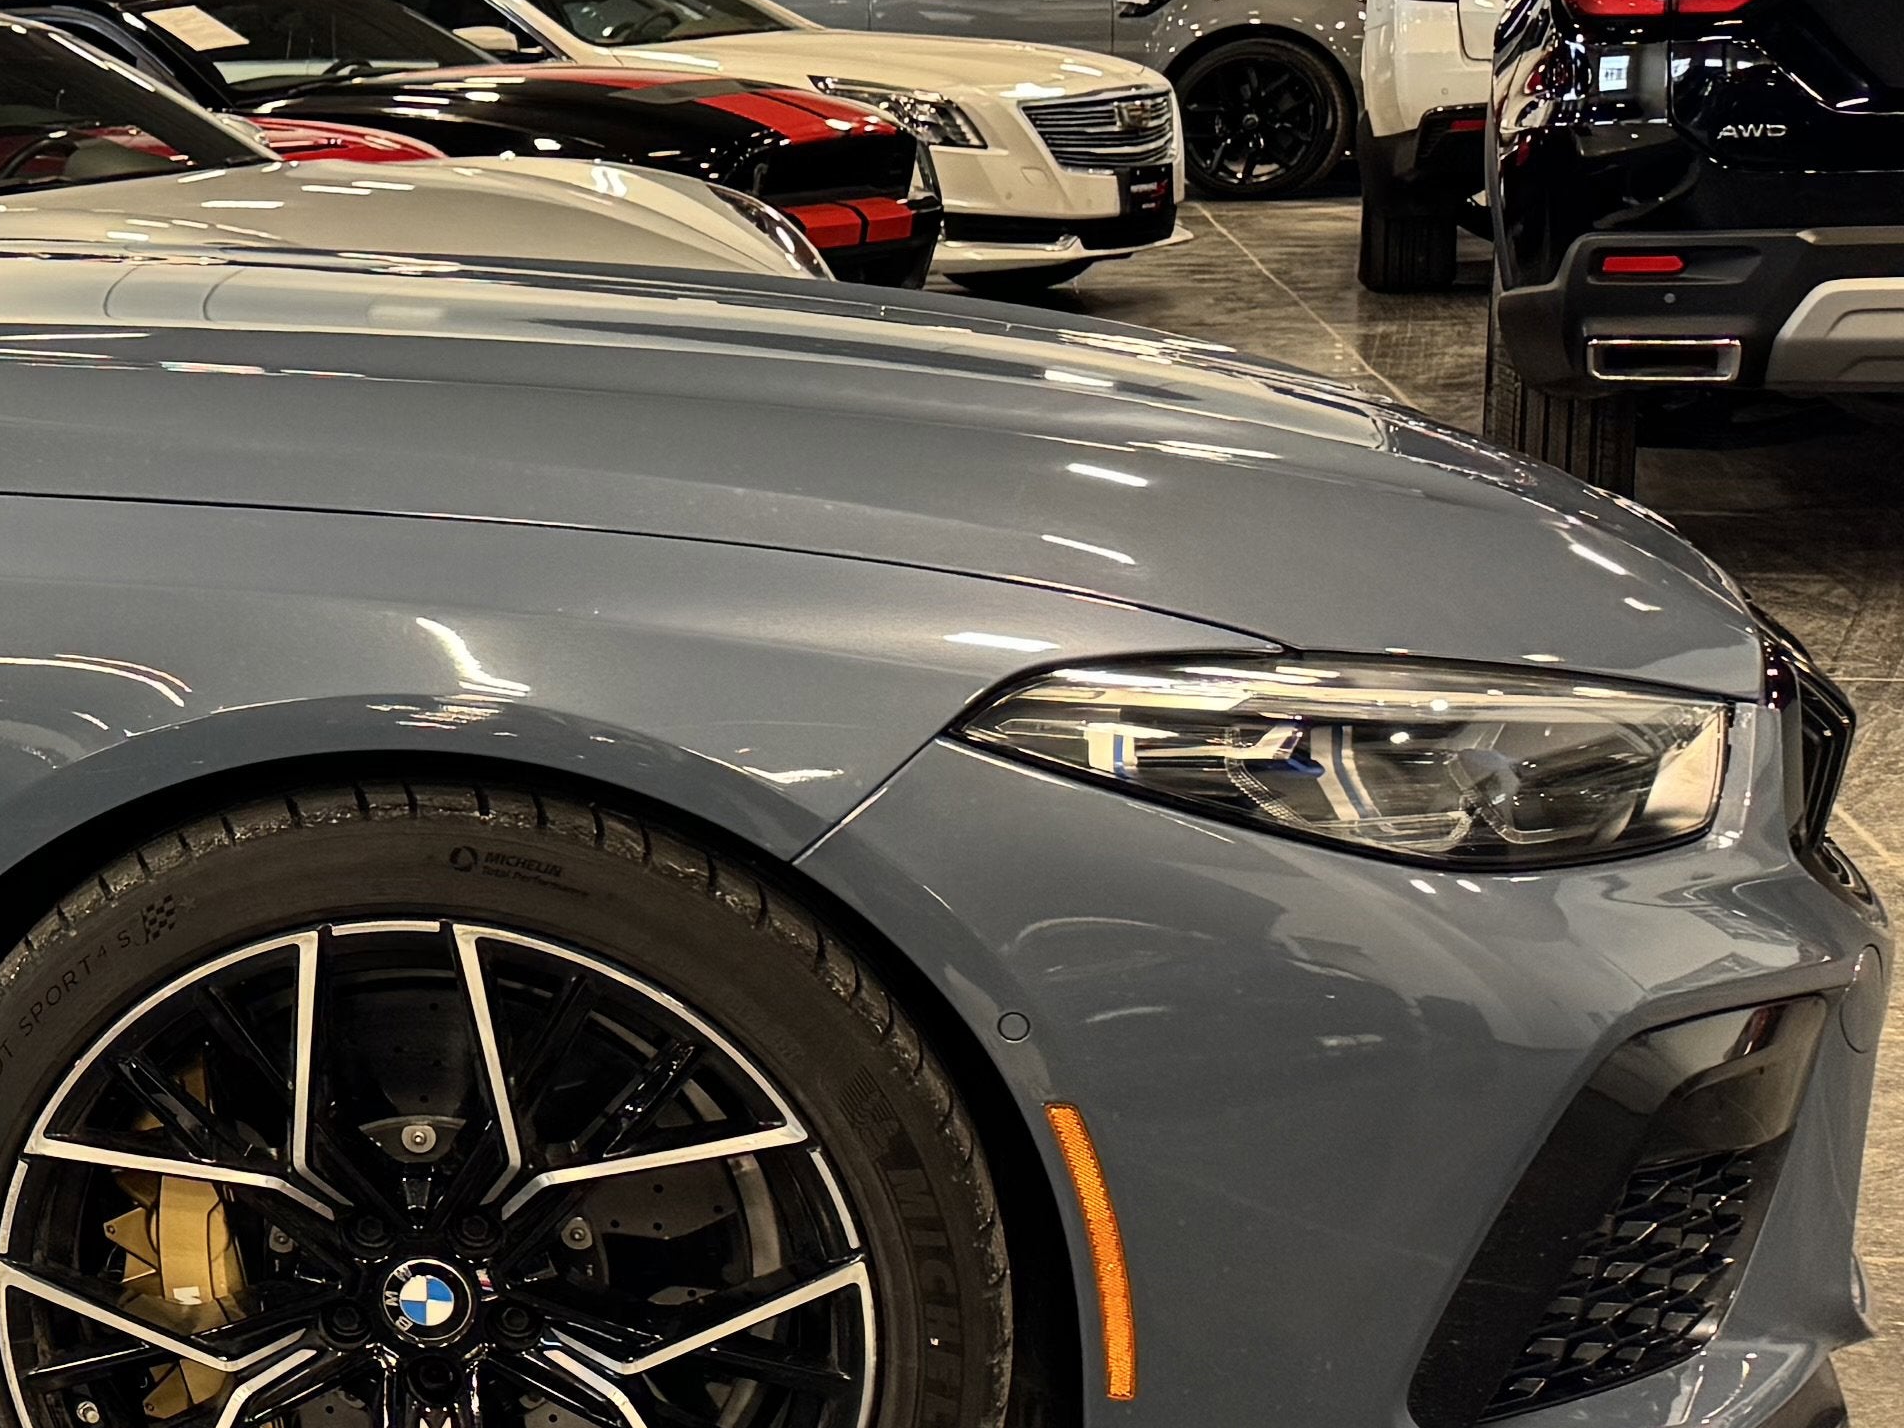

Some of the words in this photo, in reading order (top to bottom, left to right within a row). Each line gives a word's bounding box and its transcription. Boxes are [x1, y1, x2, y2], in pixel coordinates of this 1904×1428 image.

[1716, 123, 1789, 140] AWD
[483, 851, 563, 878] MICHELIN
[18, 954, 93, 1038] SPORT
[117, 929, 132, 948] S
